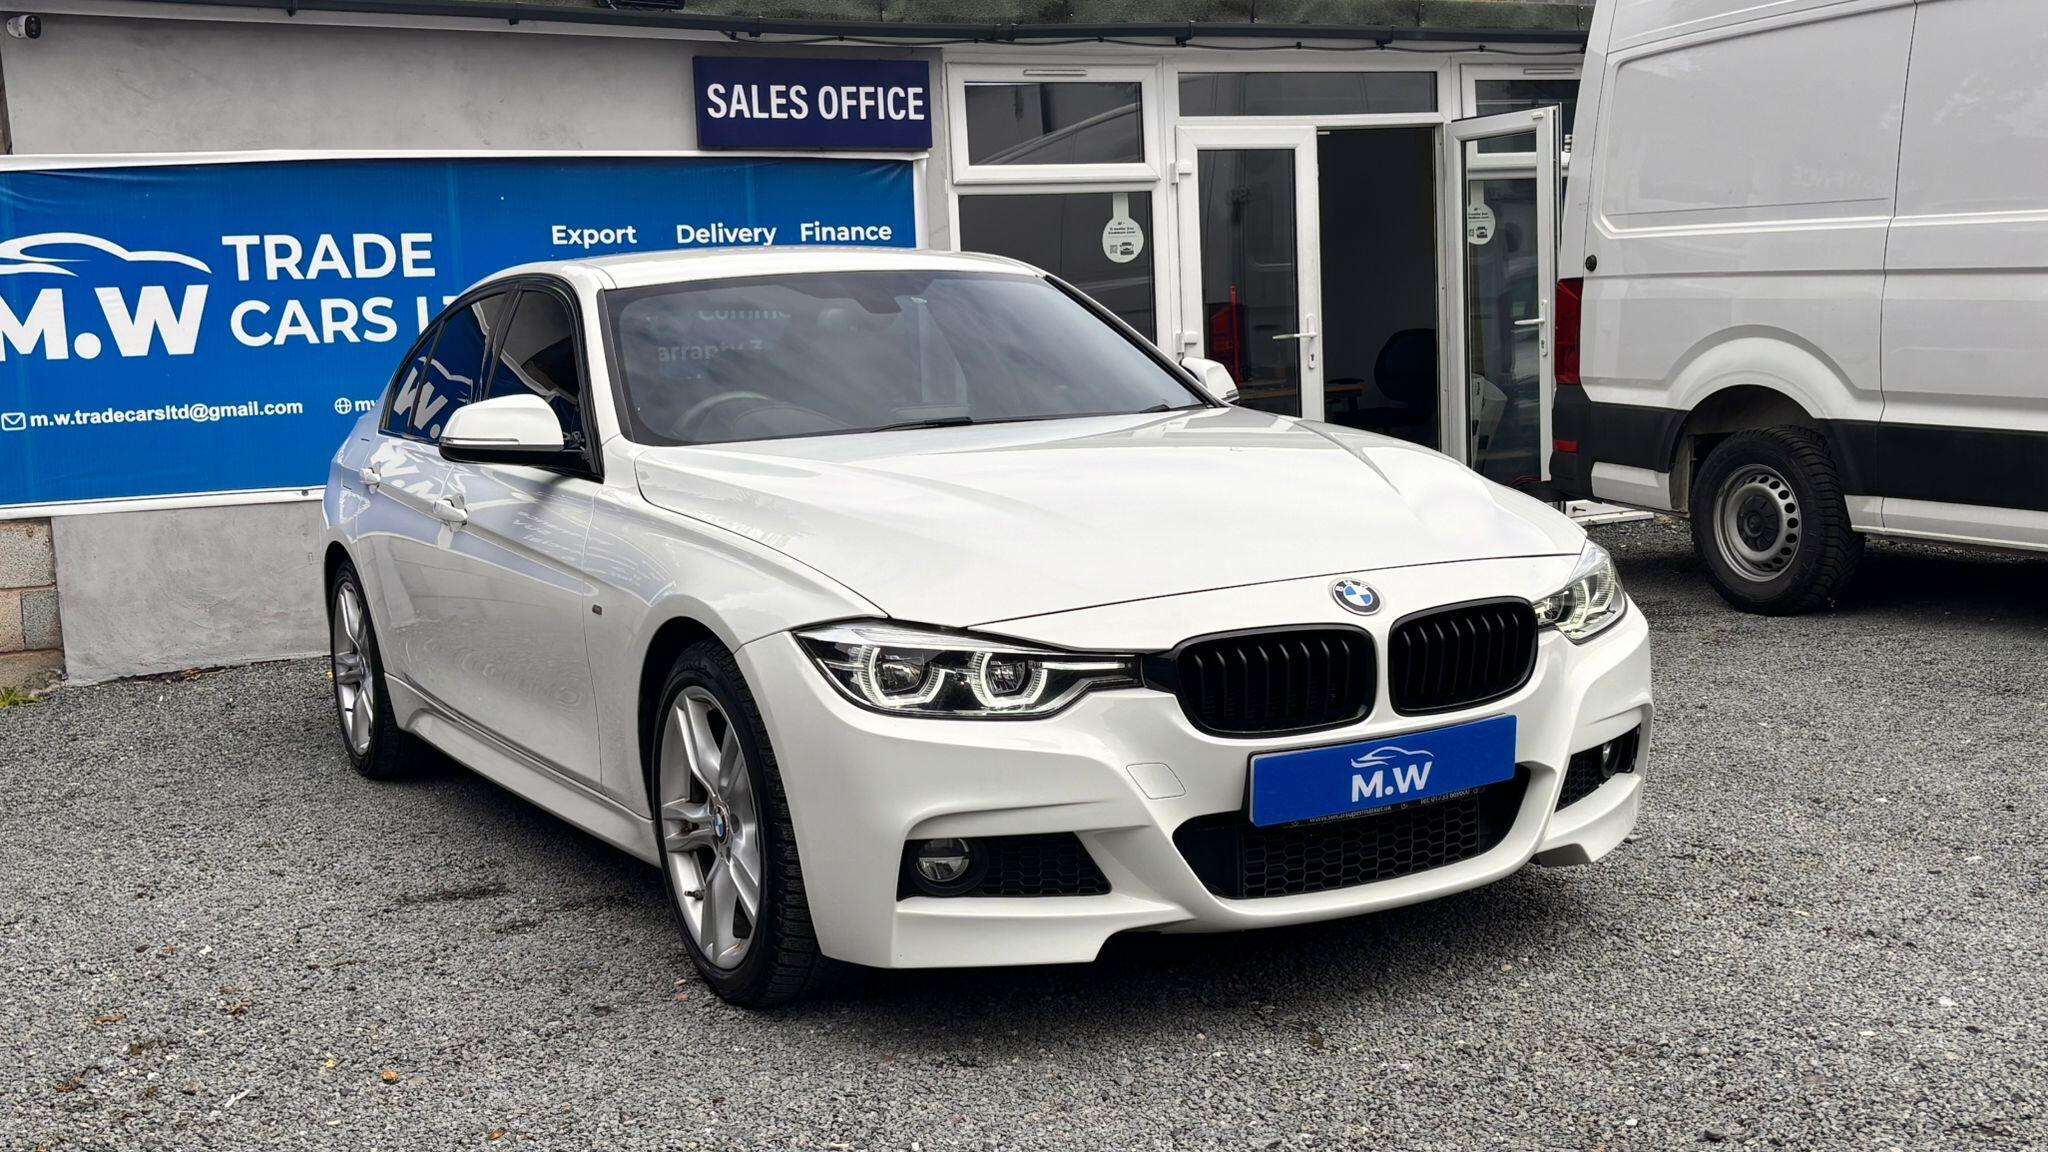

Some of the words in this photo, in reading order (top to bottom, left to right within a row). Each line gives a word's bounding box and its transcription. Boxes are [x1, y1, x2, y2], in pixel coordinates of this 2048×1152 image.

[707, 83, 809, 120] SALES
[818, 85, 925, 121] OFFICE
[551, 225, 638, 249] Export
[676, 222, 778, 247] Delivery
[800, 221, 893, 242] Finance
[221, 232, 436, 281] TRADE
[0, 284, 209, 362] M.W
[230, 296, 398, 347] CARS
[30, 400, 304, 427] m.w.tradecarsltd@gmail.com
[1351, 761, 1433, 803] M.W
